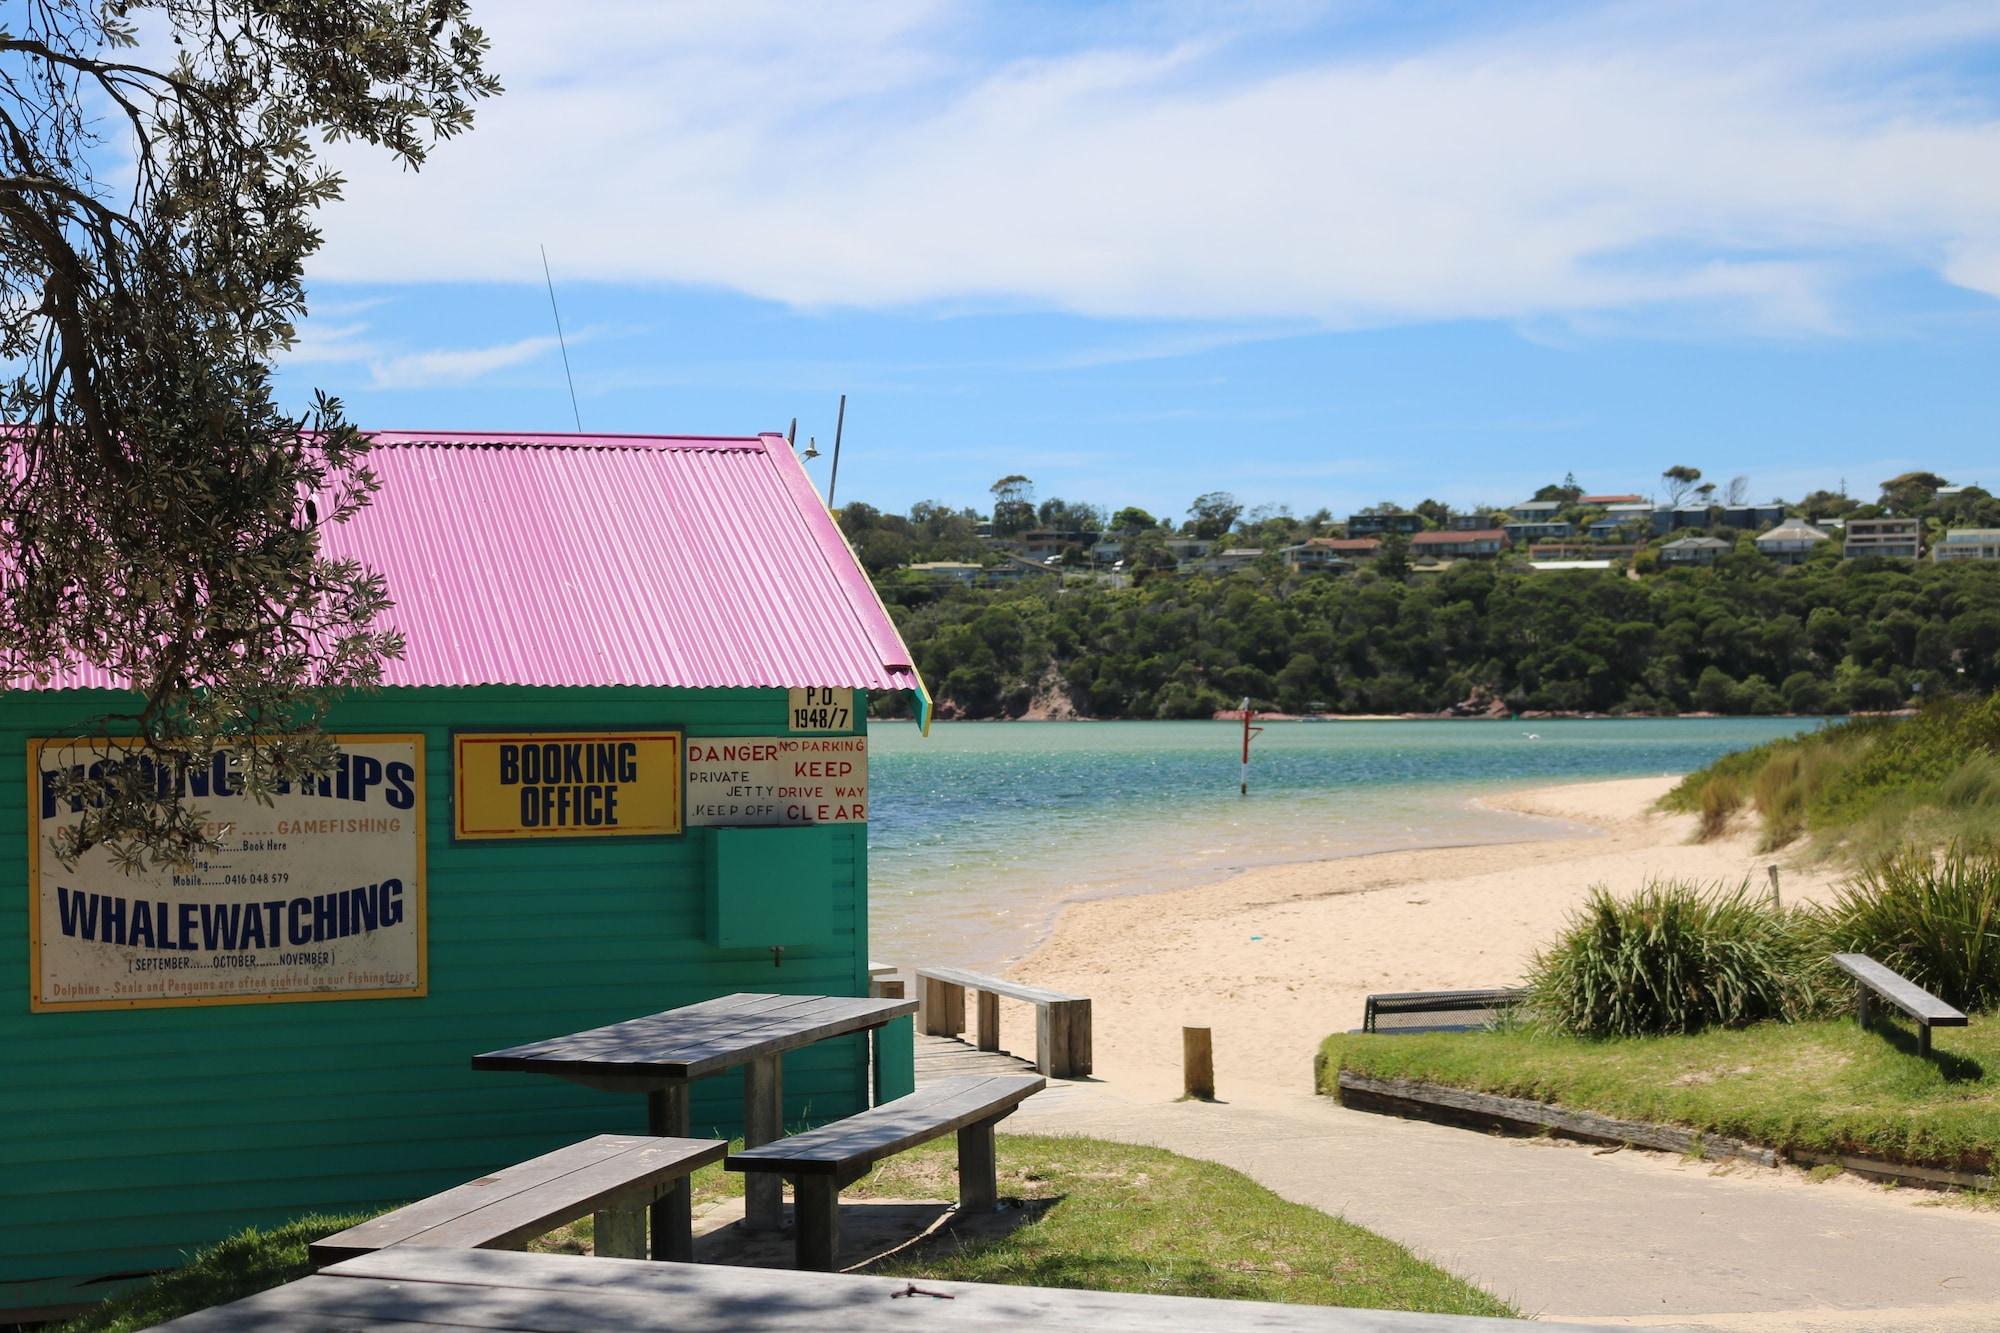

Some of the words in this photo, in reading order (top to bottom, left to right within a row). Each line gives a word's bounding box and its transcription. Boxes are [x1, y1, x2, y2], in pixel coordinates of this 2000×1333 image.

[807, 687, 837, 706] P.O.
[794, 708, 848, 728] 1948/7
[689, 745, 778, 762] DANGER
[802, 740, 864, 752] PARKING
[500, 743, 637, 784] BOOKING
[795, 762, 852, 777] KEEP
[272, 752, 415, 810] IPS
[690, 772, 749, 783] PRIVATE
[726, 786, 774, 797] JETTY
[778, 787, 823, 797] DRIVE
[835, 787, 864, 797] WAY
[521, 785, 618, 827] OFFICE
[696, 806, 738, 816] KEEP
[745, 805, 774, 816] OFF
[787, 804, 864, 820] CLEAR
[277, 818, 401, 835] GAMEFISHING
[267, 839, 287, 851] Here
[250, 874, 269, 884] 048
[271, 873, 289, 884] 579
[57, 878, 403, 951] WHALEWATCHING
[53, 982, 100, 997] Dolphins
[114, 980, 142, 994] Seals
[168, 977, 215, 994] Penguins
[327, 973, 344, 984] our
